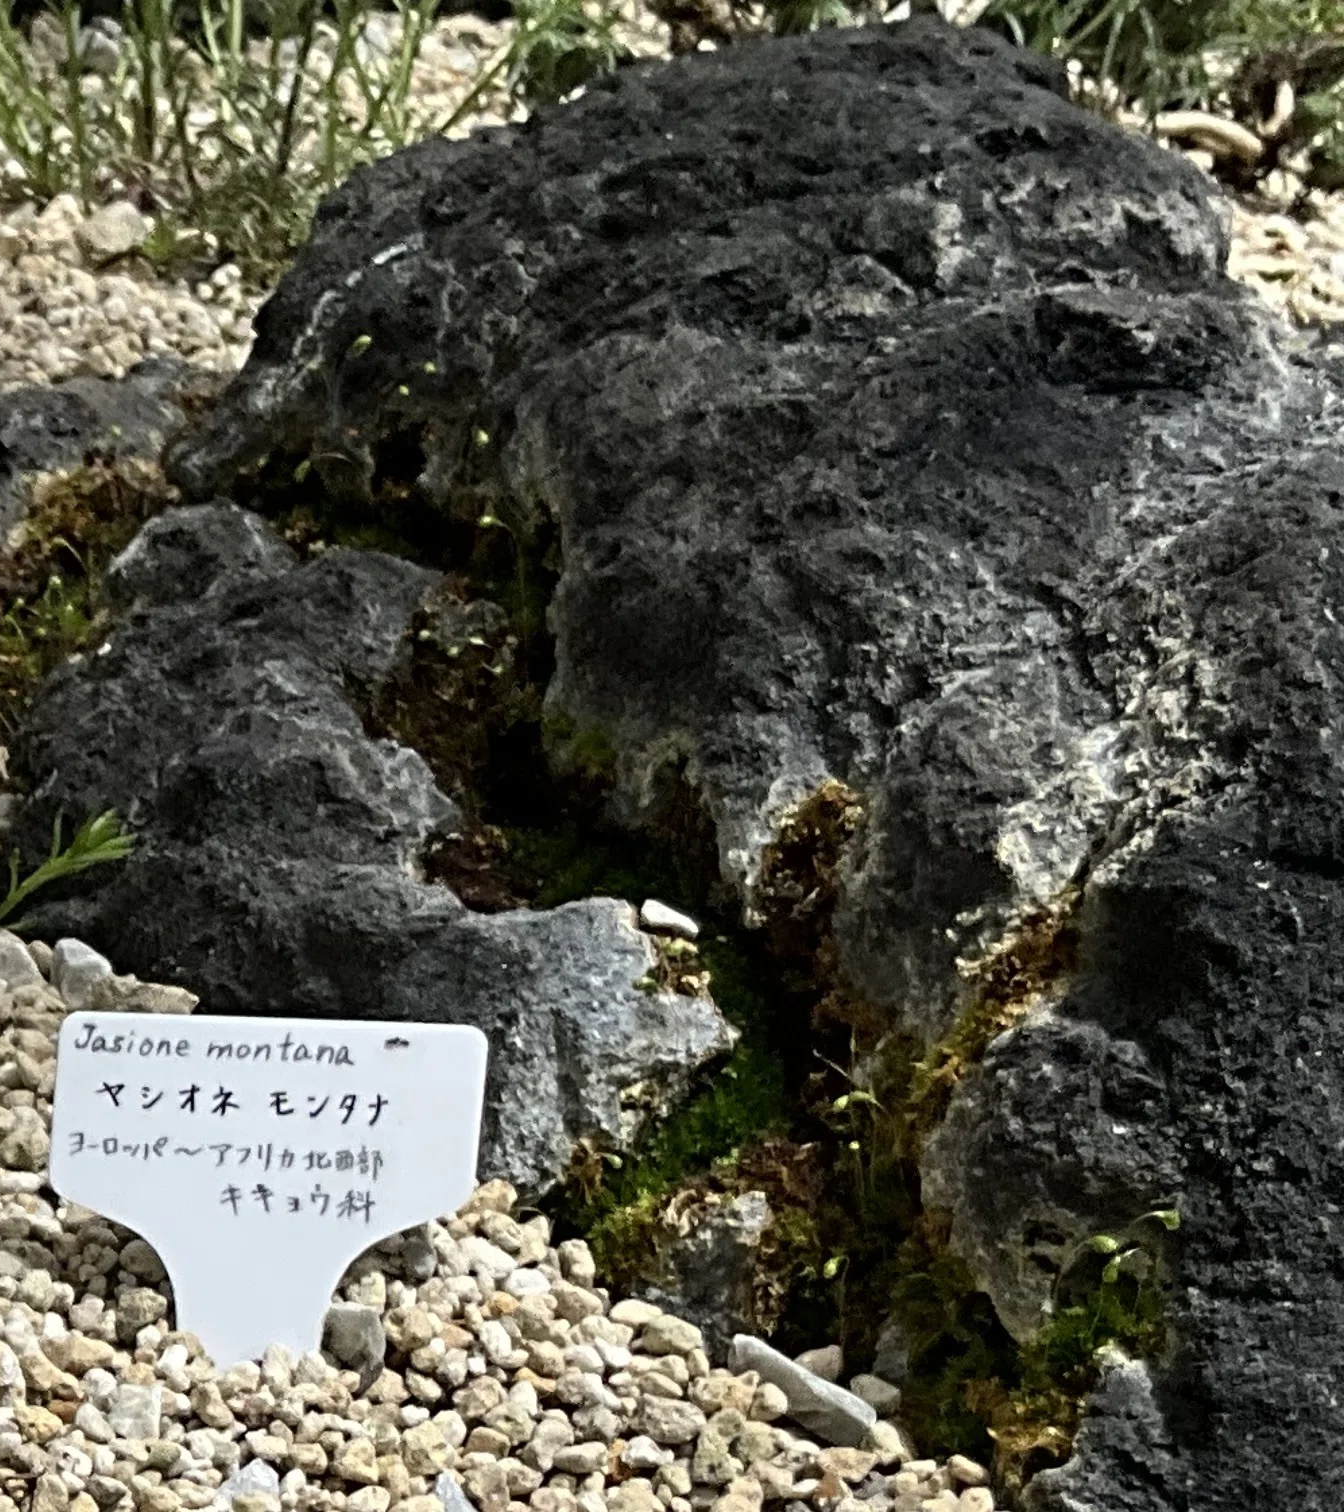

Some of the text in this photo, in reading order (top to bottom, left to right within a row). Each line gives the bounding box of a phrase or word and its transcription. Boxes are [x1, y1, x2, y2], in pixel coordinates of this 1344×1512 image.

[74, 1023, 355, 1067] Jasione montana
[94, 1082, 389, 1127] ヤシオネ モンタナ
[220, 1184, 376, 1224] キキョウ科
